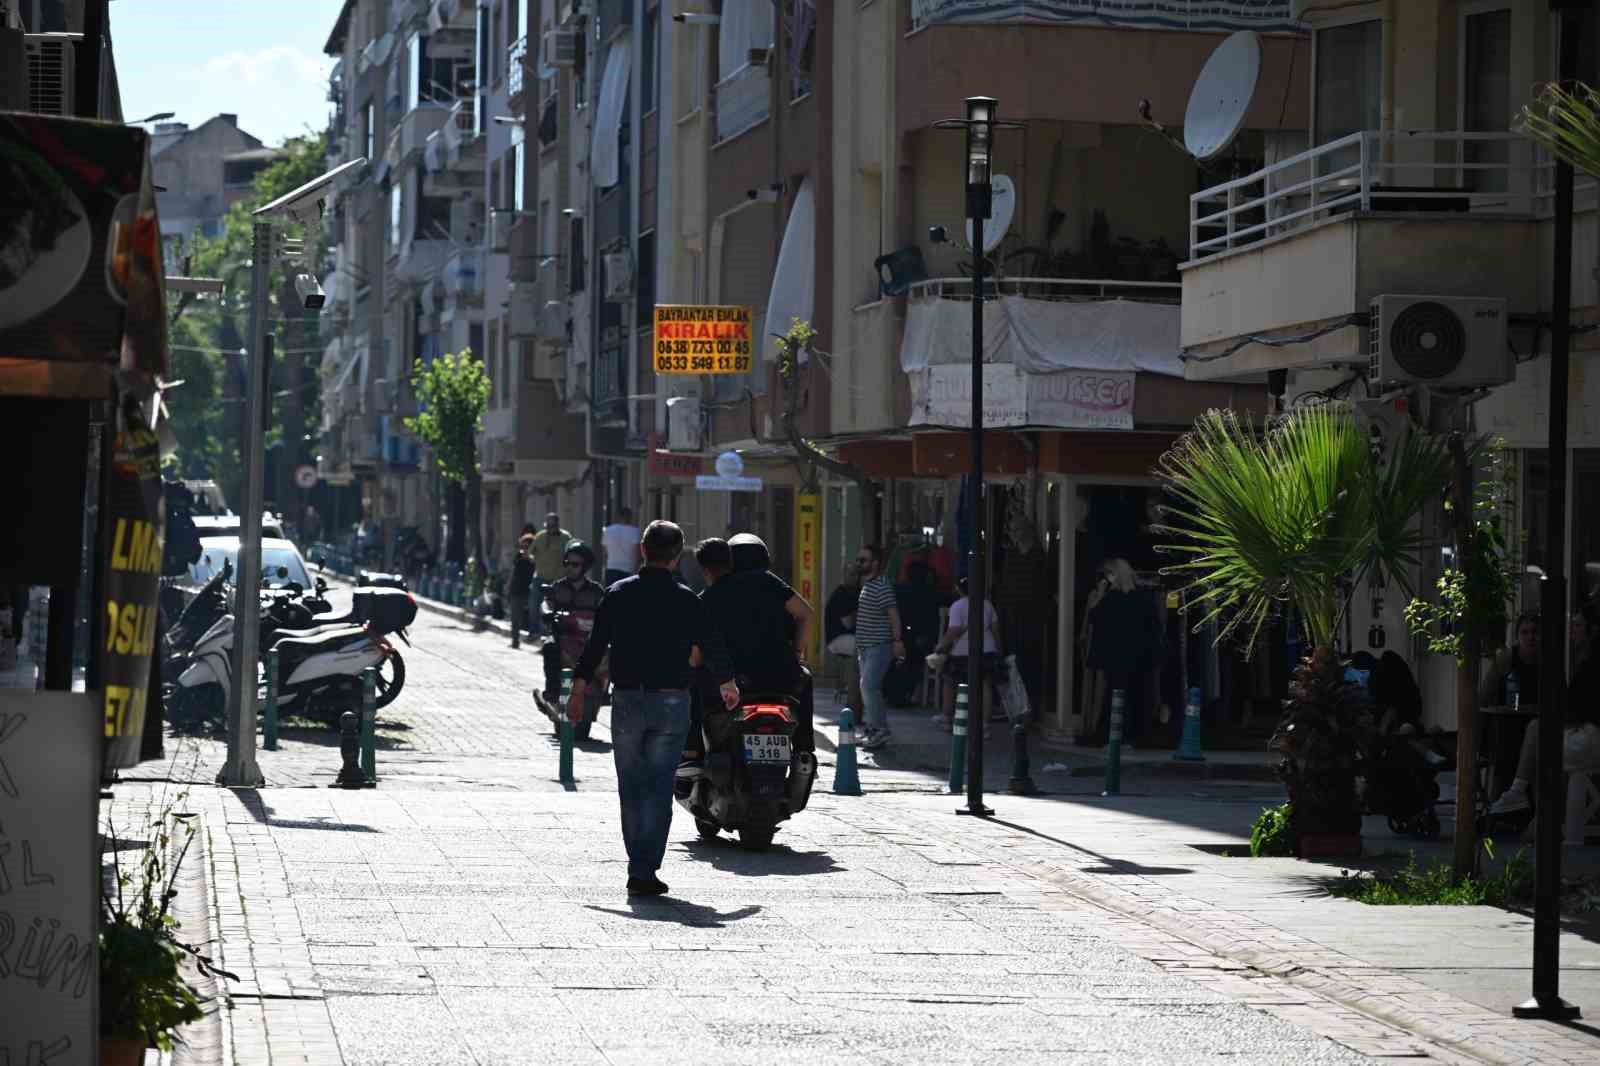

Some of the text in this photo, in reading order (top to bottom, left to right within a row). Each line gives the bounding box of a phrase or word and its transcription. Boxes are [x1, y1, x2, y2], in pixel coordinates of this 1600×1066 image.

[690, 341, 713, 354] 773
[717, 341, 732, 354] 00
[658, 356, 687, 370] 0533
[718, 356, 730, 370] 11
[746, 736, 787, 746] 45 AUB
